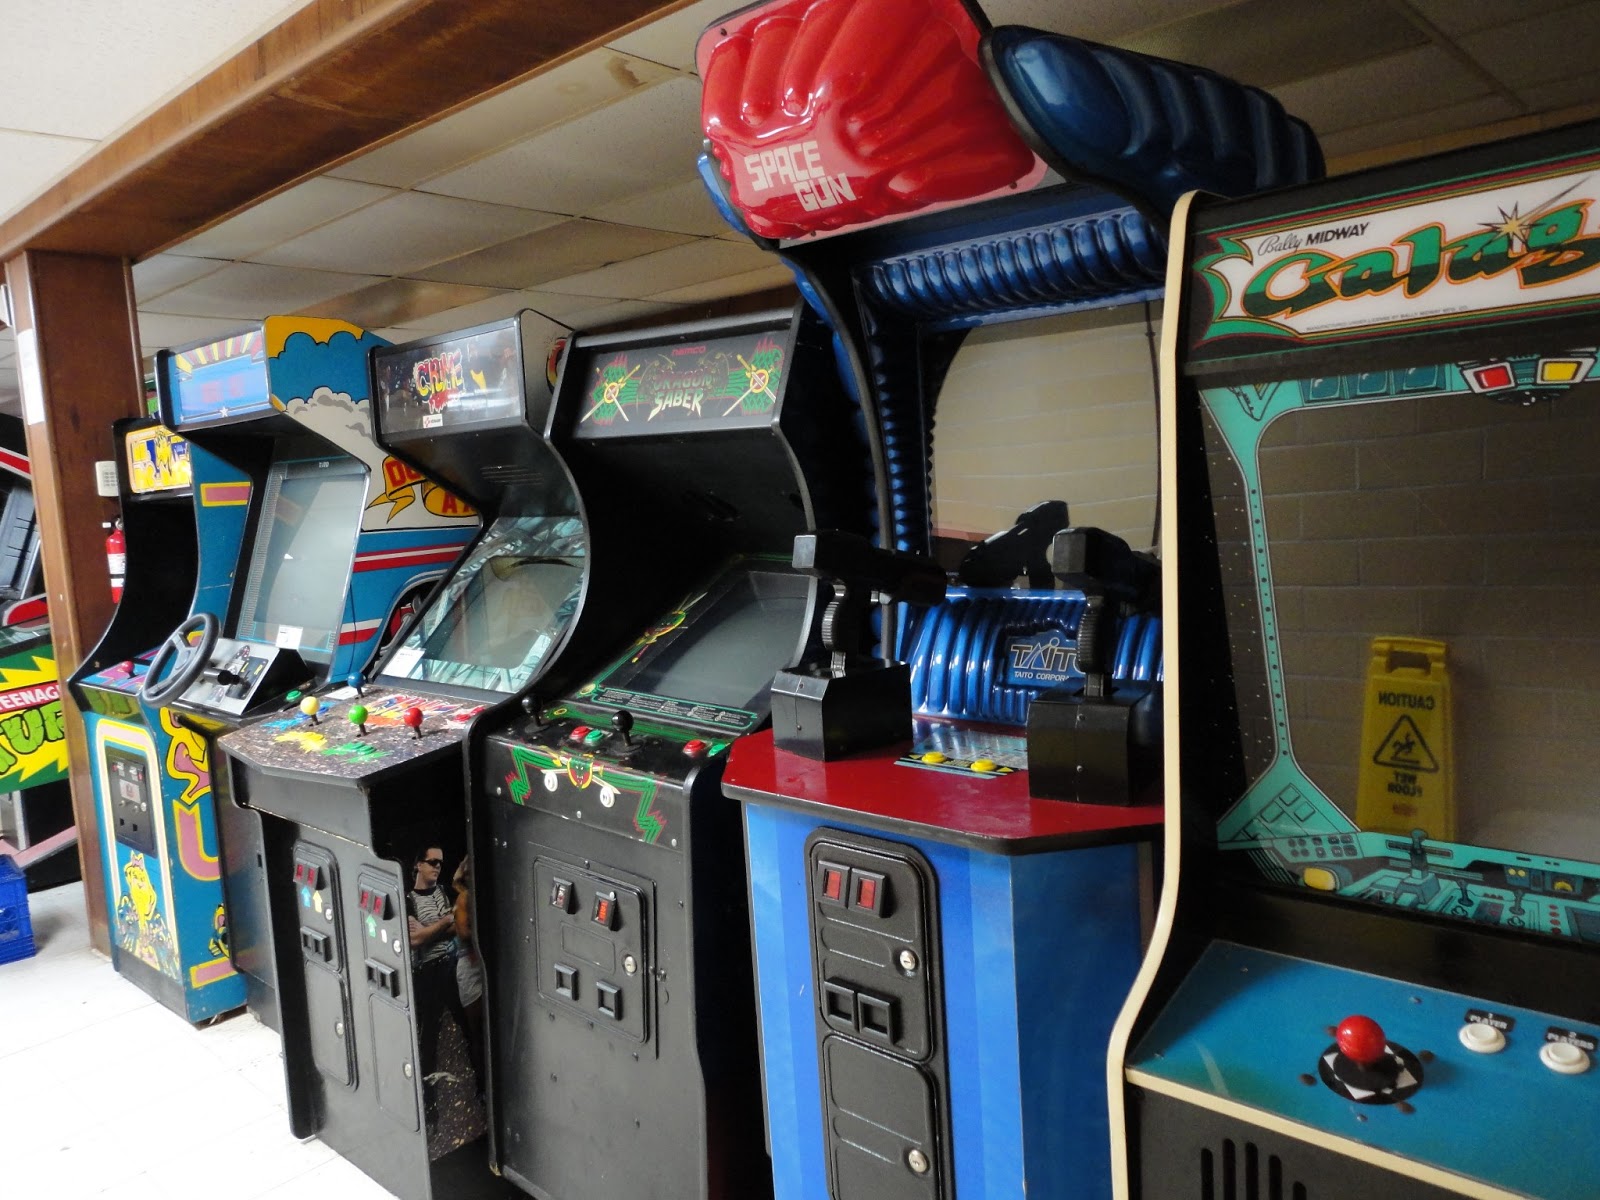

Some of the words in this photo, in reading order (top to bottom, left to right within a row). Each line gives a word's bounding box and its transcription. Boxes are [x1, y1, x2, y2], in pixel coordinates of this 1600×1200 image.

[744, 140, 825, 191] SPACE
[793, 172, 857, 212] GUN
[1257, 232, 1303, 256] Bally
[1305, 221, 1370, 247] MIDWAY
[1241, 198, 1600, 319] Galag
[648, 388, 704, 421] SABER
[1014, 670, 1034, 679] TAITO
[1036, 672, 1070, 682] CORPOR
[0, 684, 60, 711] EENAG
